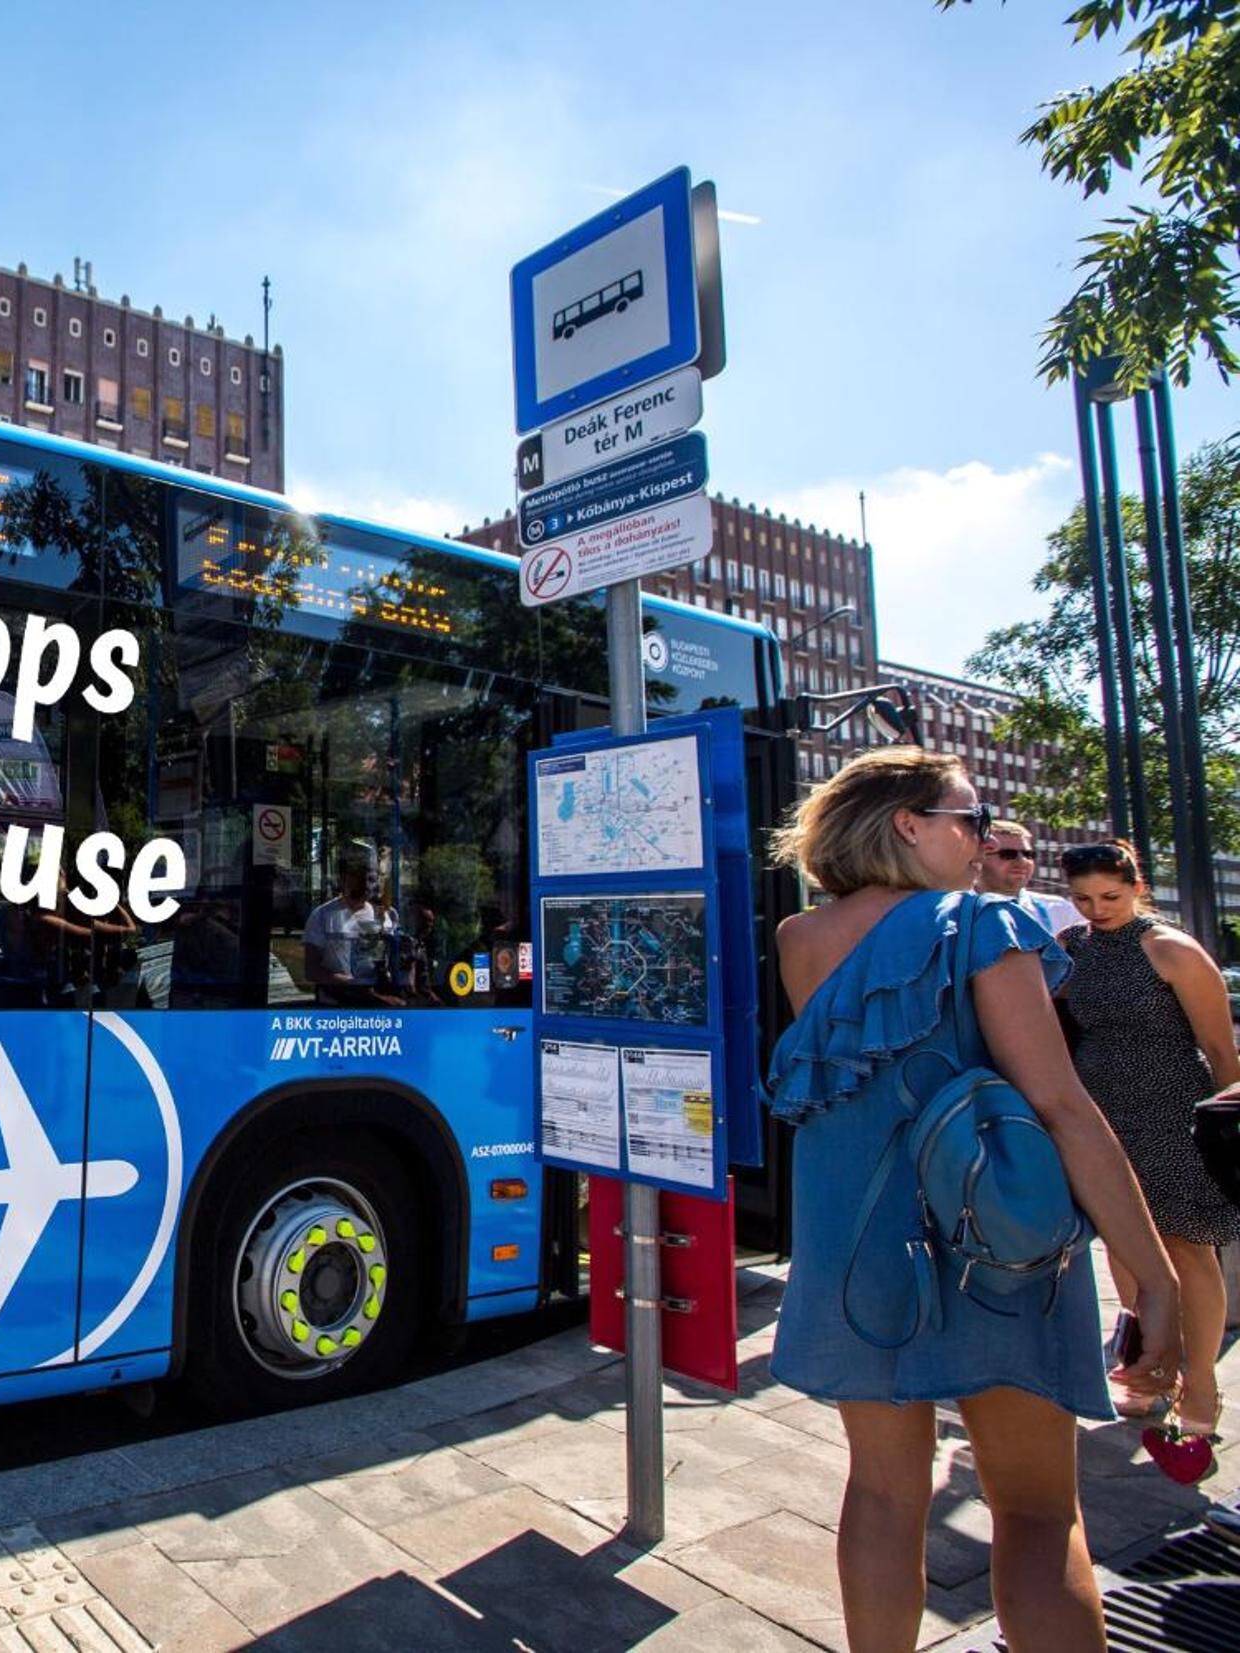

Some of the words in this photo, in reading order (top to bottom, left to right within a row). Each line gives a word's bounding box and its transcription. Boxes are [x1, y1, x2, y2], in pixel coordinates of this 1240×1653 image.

[564, 414, 608, 445] Deák
[614, 387, 675, 424] Ferenc
[594, 431, 619, 454] tér
[625, 420, 643, 443] M
[523, 453, 539, 475] M
[583, 472, 609, 488] busz
[577, 537, 586, 547] A
[272, 1017, 282, 1030] A
[286, 1016, 312, 1030] BKK
[316, 1015, 392, 1034] szolgáltatója
[395, 1018, 403, 1029] a
[297, 1036, 402, 1059] VT-ARRIVA
